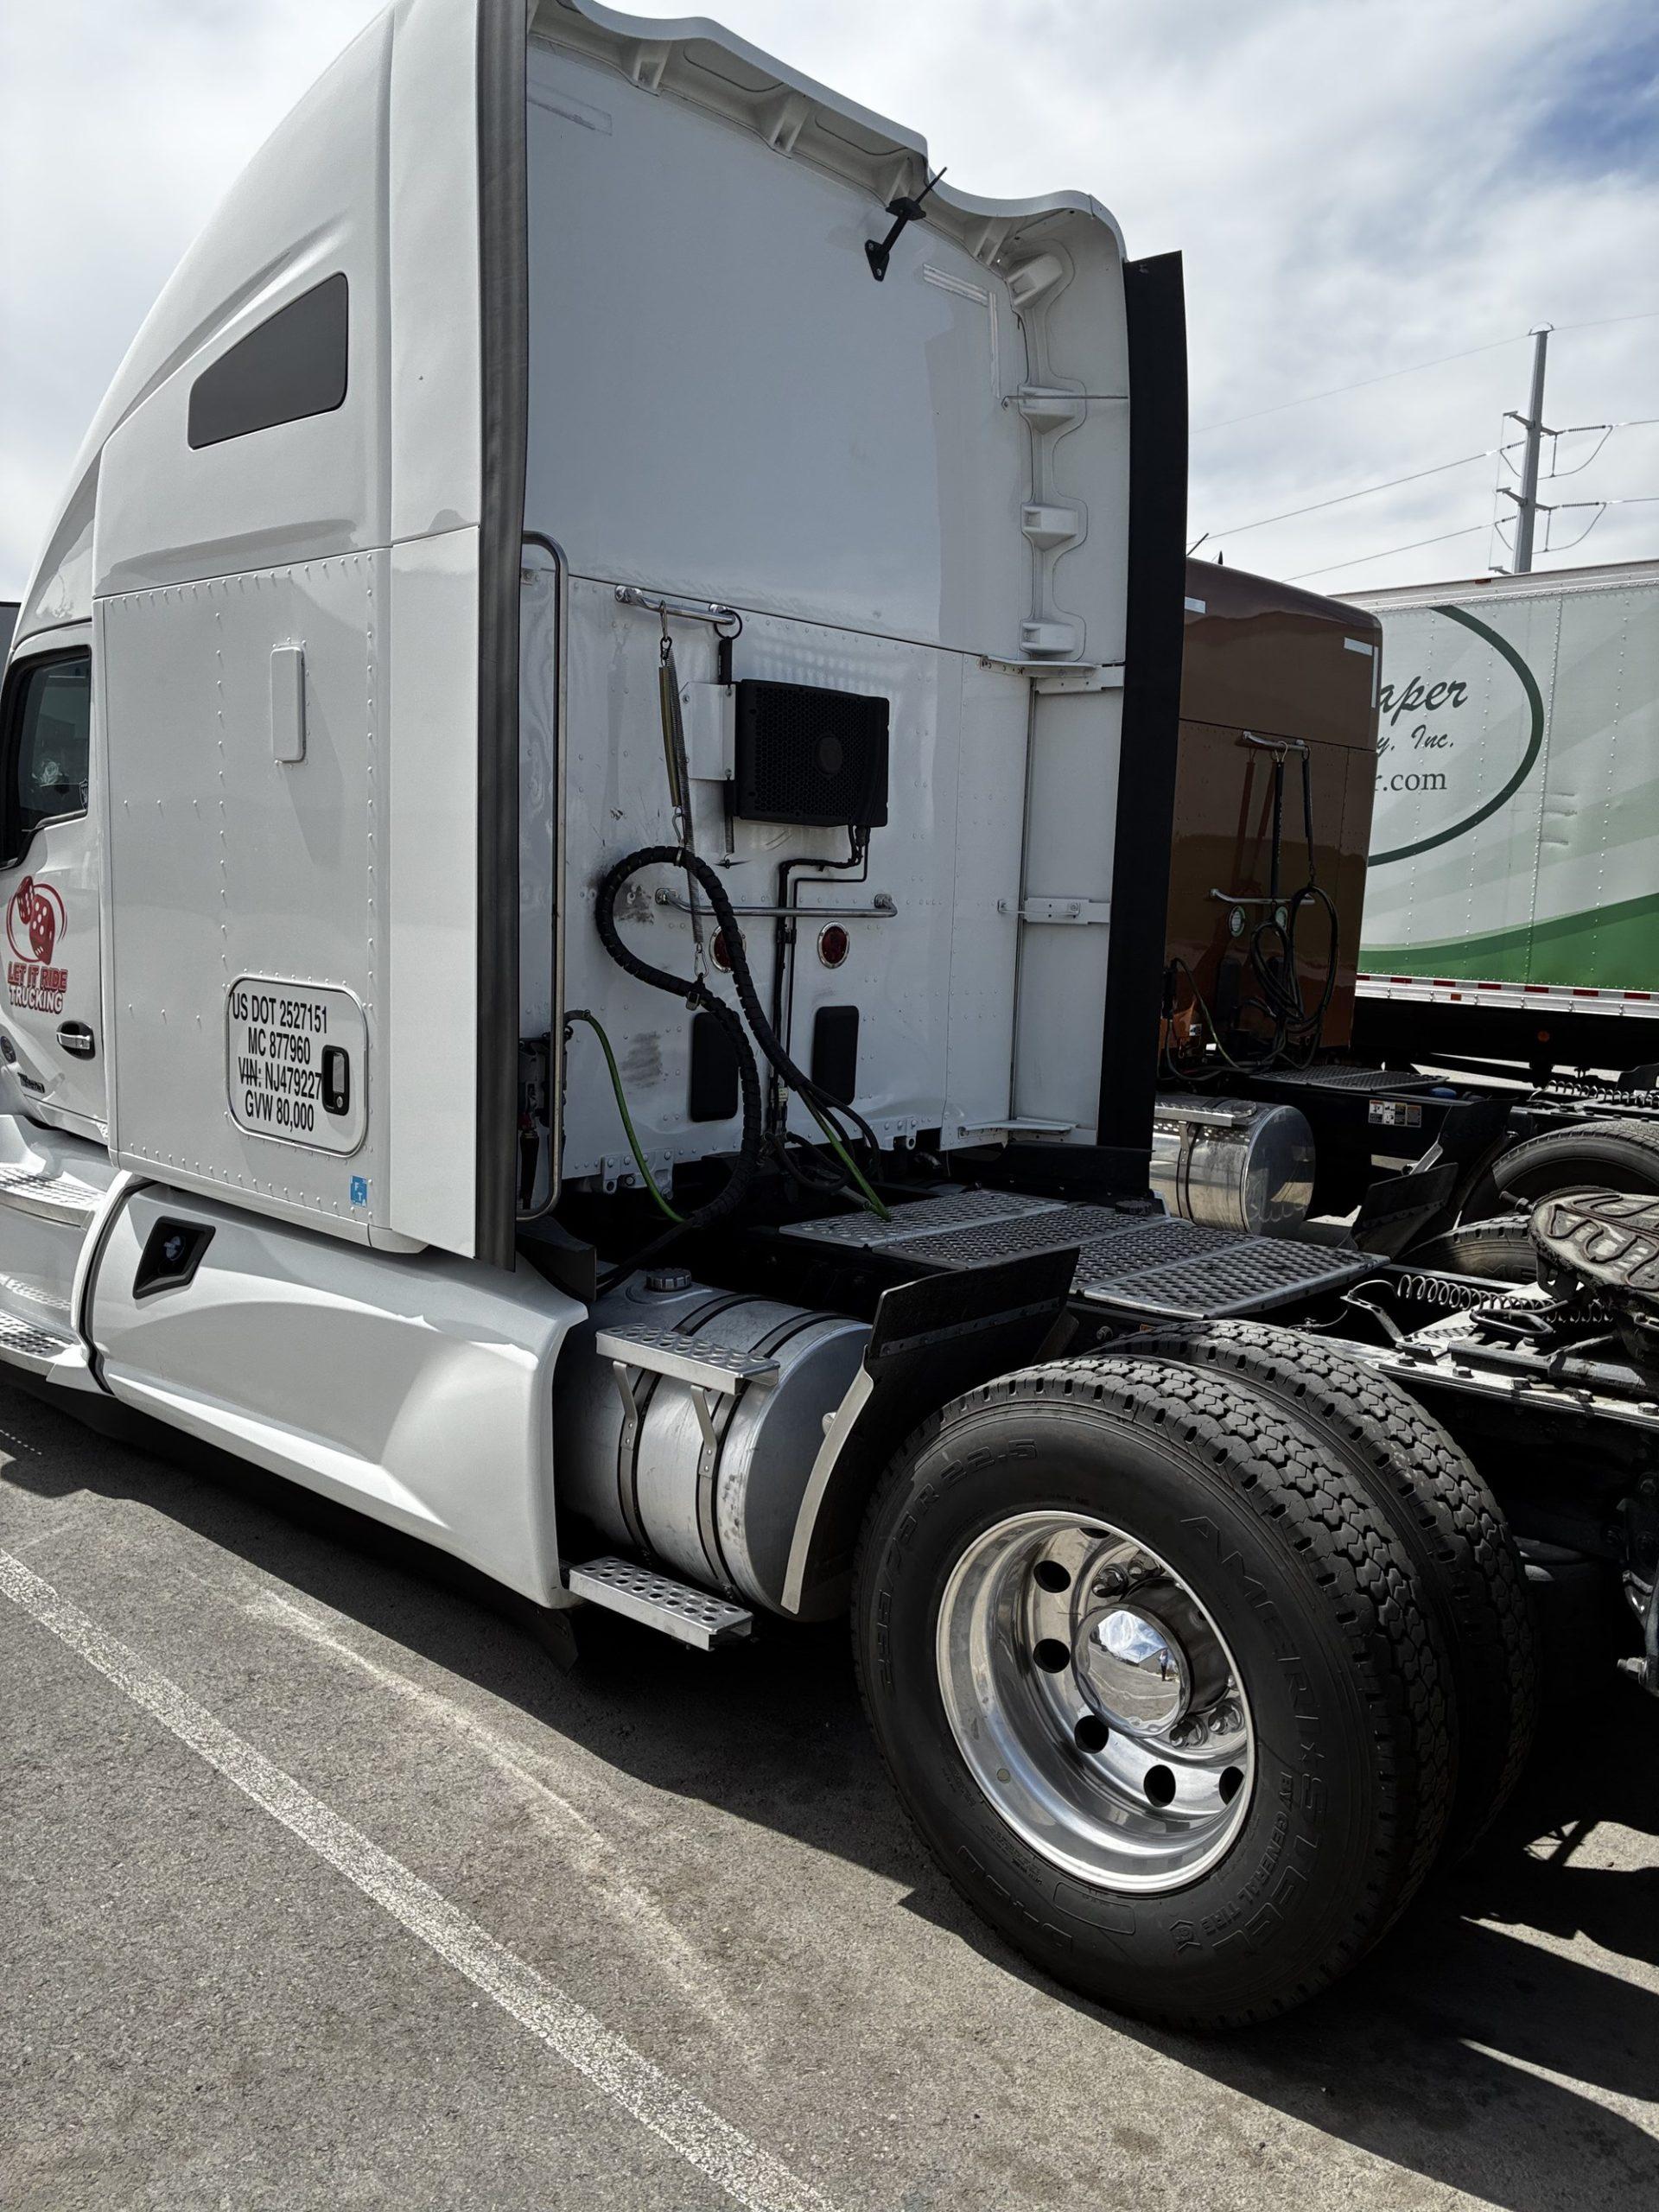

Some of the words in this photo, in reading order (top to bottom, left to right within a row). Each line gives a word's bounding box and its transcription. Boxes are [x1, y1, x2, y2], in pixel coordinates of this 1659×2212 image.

[1411, 724, 1453, 749] Inc.
[8, 961, 27, 985] LET
[28, 964, 40, 988] IT
[40, 966, 68, 993] RIDE
[10, 985, 63, 1014] TRUCKING
[232, 993, 248, 1020] US
[252, 995, 276, 1025] DOT
[279, 1000, 327, 1033] 2527151
[248, 1027, 266, 1057] MC
[270, 1031, 310, 1065] 877960
[238, 1057, 261, 1088] VIN:
[265, 1062, 322, 1100] NJ479227
[245, 1090, 273, 1122] GVW
[276, 1097, 314, 1132] 80,000
[1275, 1770, 1294, 1814] BY
[1236, 1810, 1291, 1903] GENERAL
[1199, 1899, 1243, 1935] TIRE
